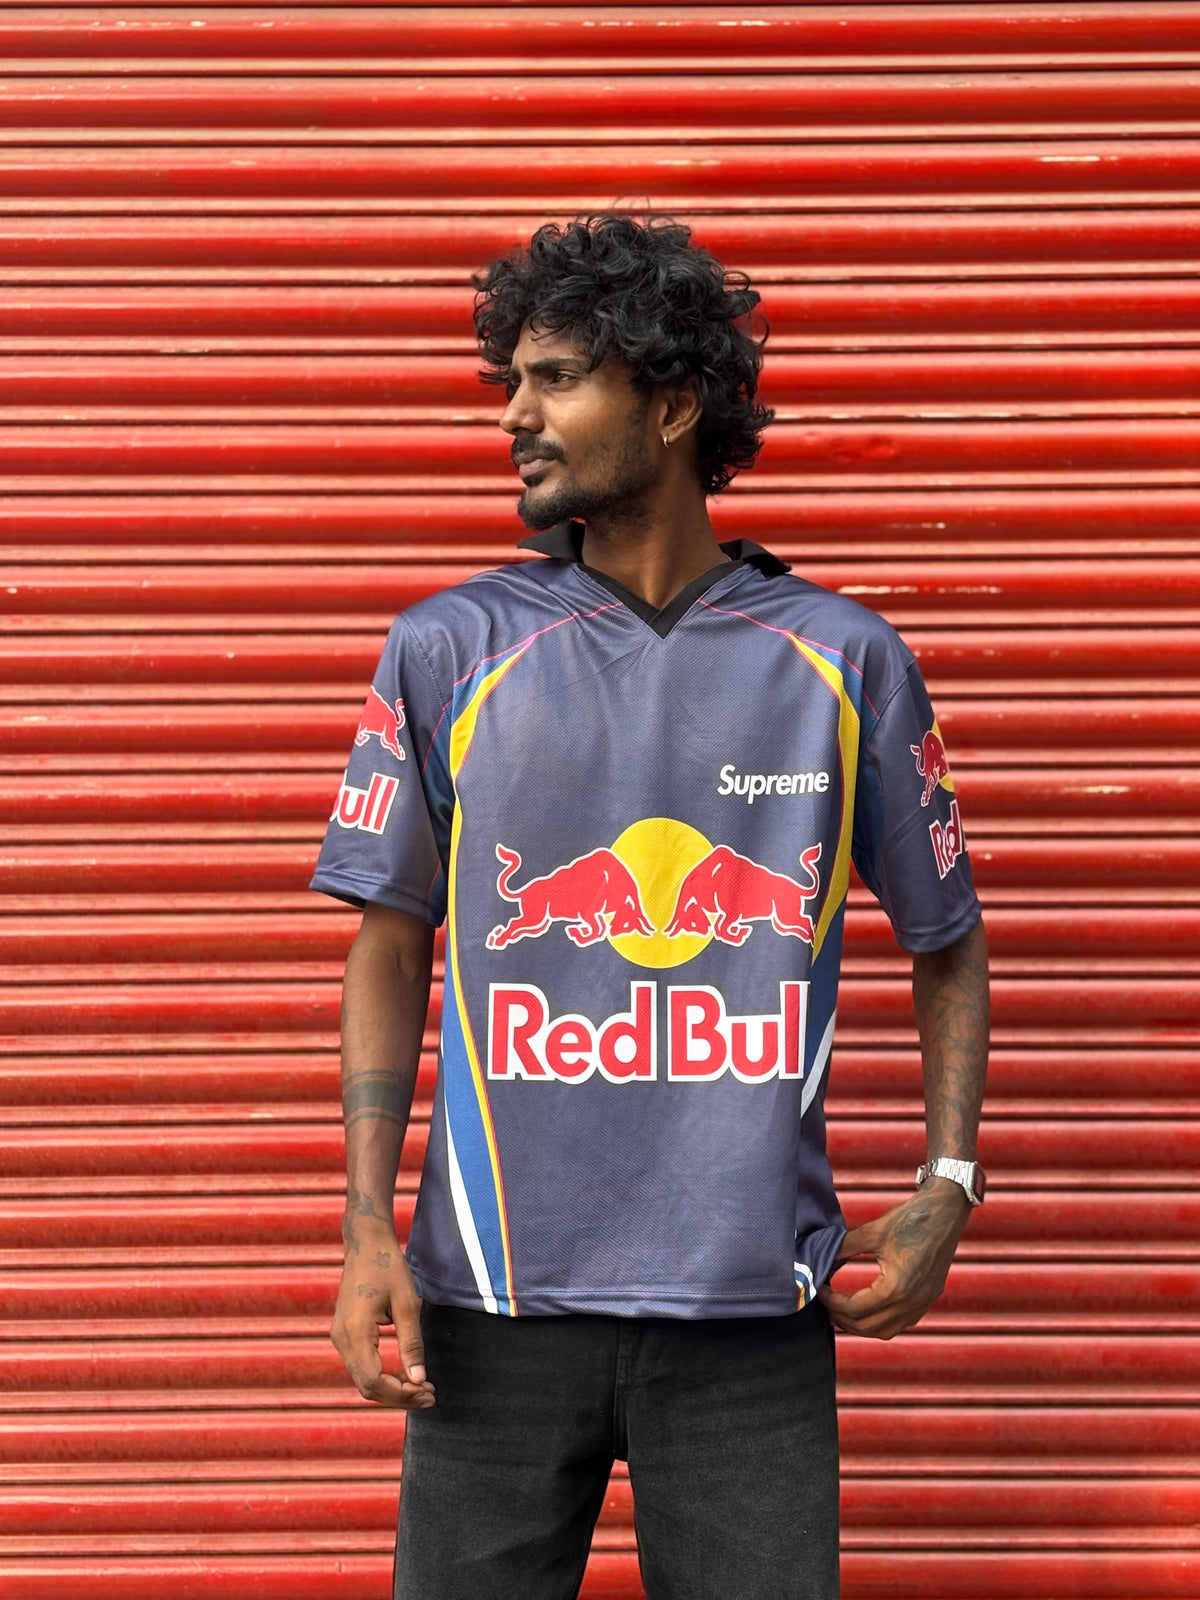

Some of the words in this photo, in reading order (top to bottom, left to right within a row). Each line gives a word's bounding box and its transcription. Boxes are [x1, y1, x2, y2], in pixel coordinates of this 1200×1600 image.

[330, 769, 400, 835] ull
[717, 764, 830, 805] Supreme
[487, 981, 657, 1084] Red
[667, 981, 811, 1084] Bul
